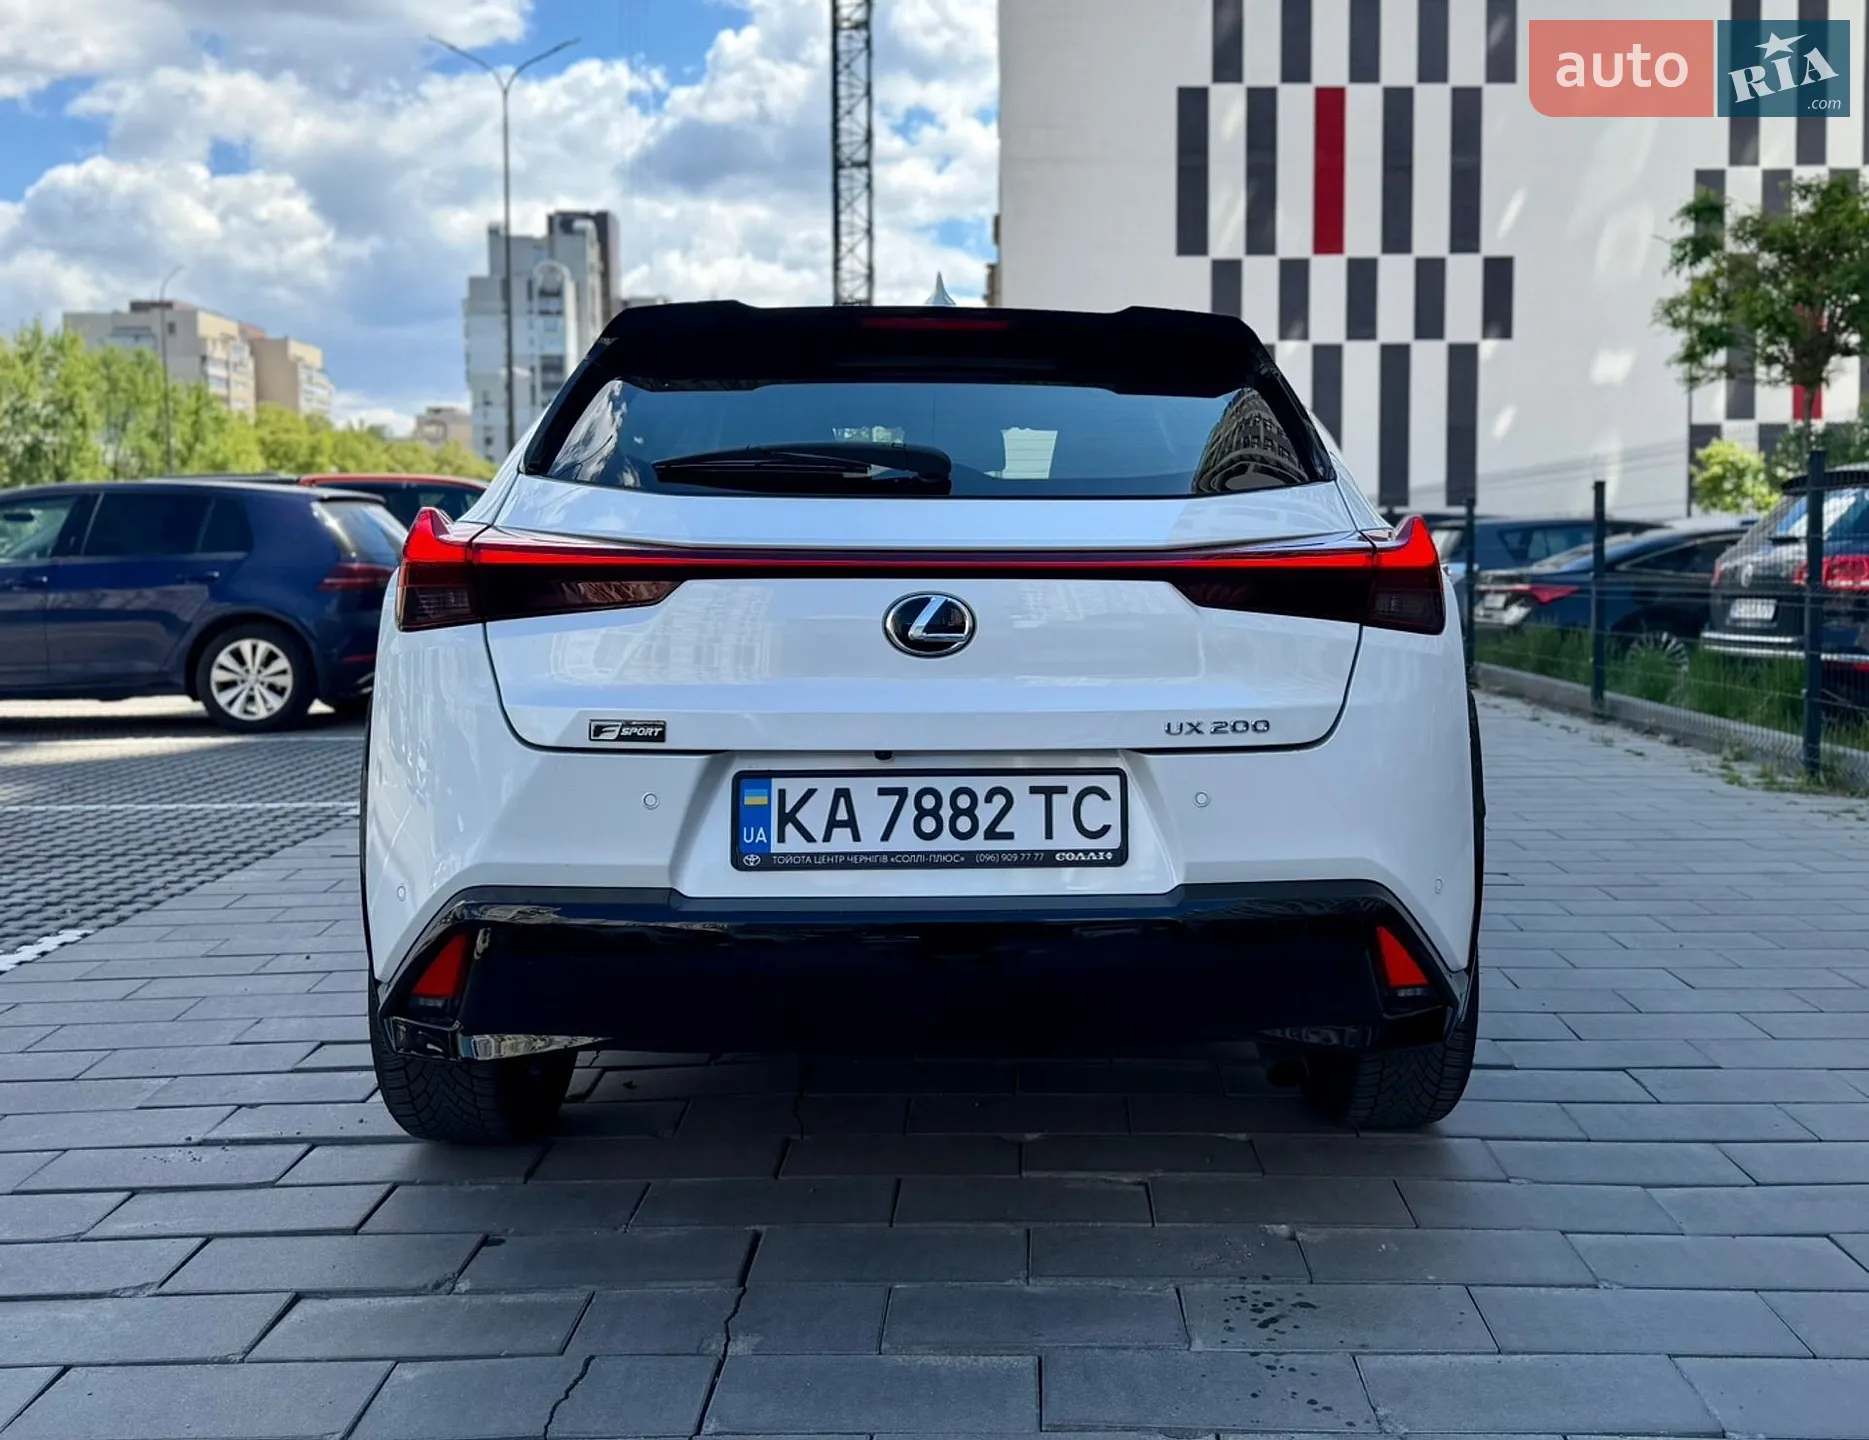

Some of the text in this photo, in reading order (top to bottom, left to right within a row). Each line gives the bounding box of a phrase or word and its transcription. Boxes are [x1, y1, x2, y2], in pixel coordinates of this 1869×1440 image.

[620, 727, 664, 737] SPORT
[1164, 719, 1271, 736] UX 200
[776, 785, 1112, 844] KA 7882 TC
[743, 826, 768, 844] UA
[773, 854, 812, 865] ТОЙОТА
[814, 855, 845, 866] ЦЕНТР
[847, 854, 889, 865] ЧЕРНІГІВ
[975, 853, 1000, 864] (096)
